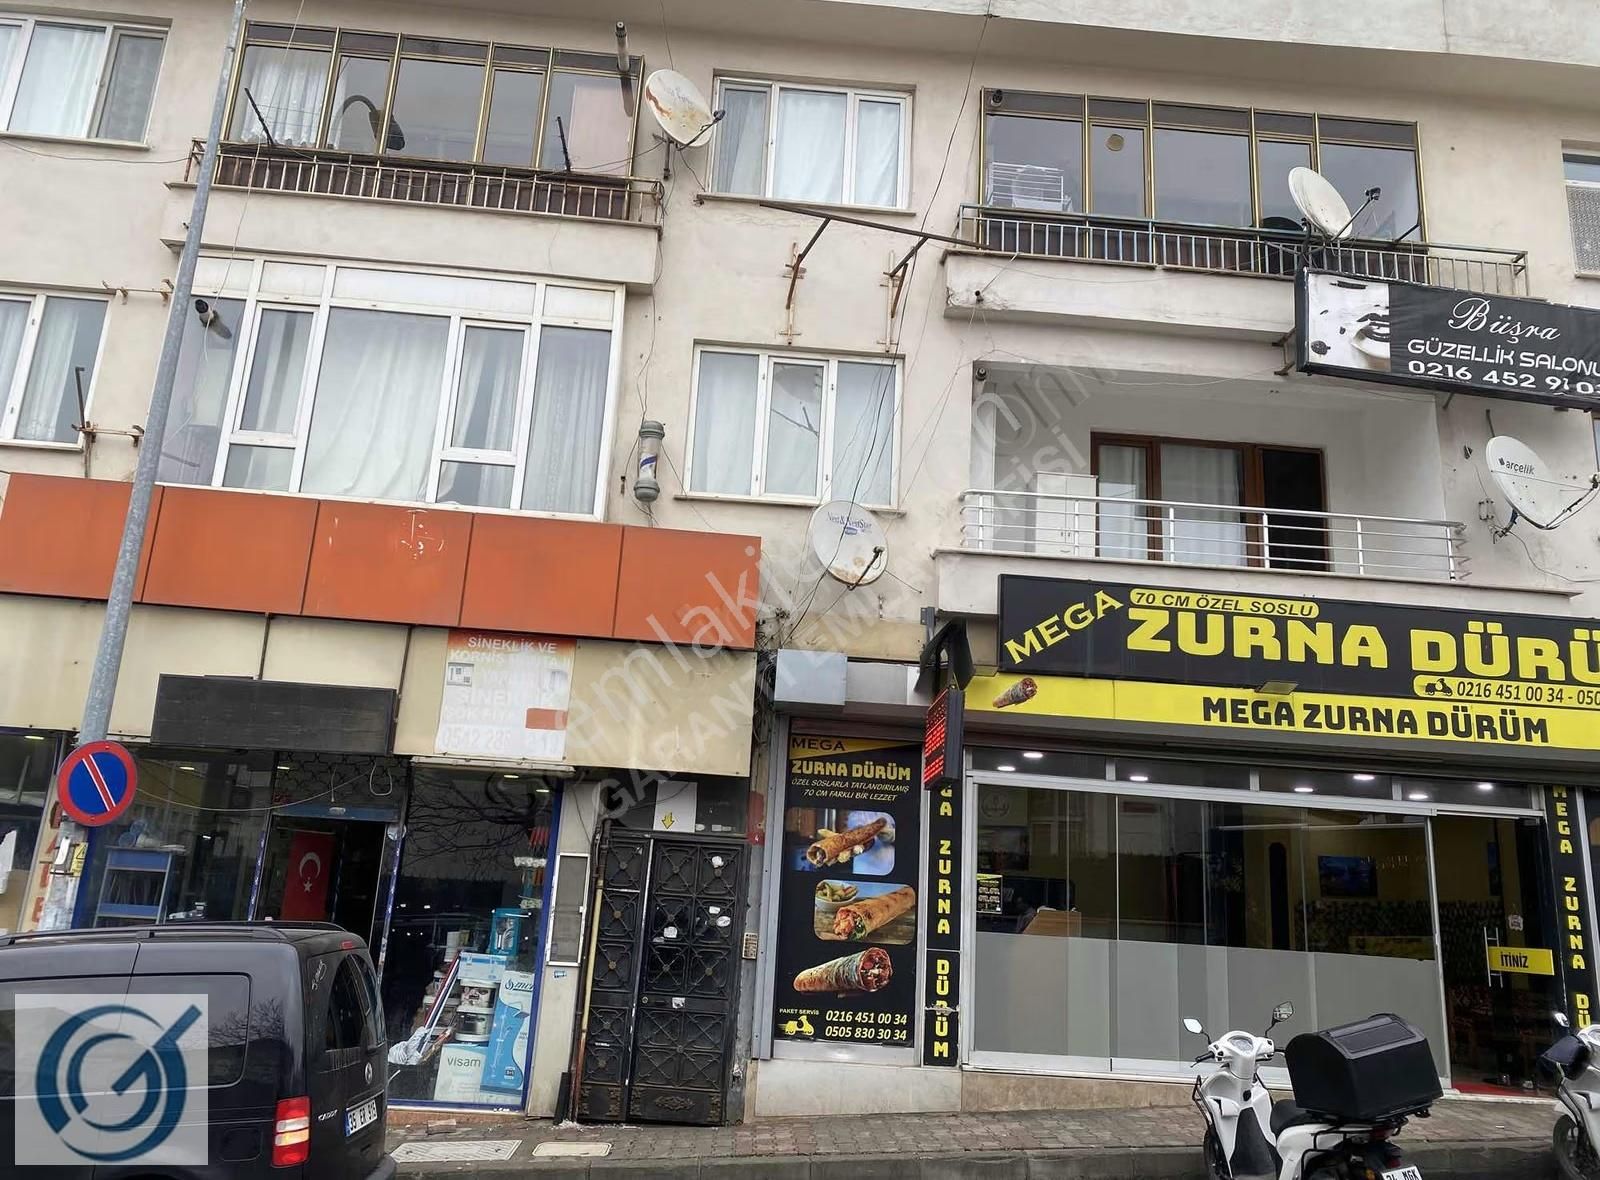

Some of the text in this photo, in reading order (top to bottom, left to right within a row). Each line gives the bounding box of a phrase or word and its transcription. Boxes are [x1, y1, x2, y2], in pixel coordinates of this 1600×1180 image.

[1448, 297, 1560, 344] Büşra
[1408, 337, 1515, 365] GÜZELLİK
[1408, 360, 1474, 381] 0216
[1483, 370, 1537, 388] 452
[1135, 592, 1314, 616] 70 CM ÖZEL SOSLU
[1004, 589, 1124, 664] MEGA
[468, 636, 557, 653] SİNEKLİK VE
[1127, 607, 1600, 685] ZURNA DÜRÜ
[1457, 681, 1491, 698] 0216
[1496, 683, 1521, 700] 451
[1525, 686, 1543, 701] 00
[1547, 687, 1564, 703] 34
[1202, 696, 1549, 743] MEGA ZURNA DÜRÜM
[792, 737, 845, 751] MEGA
[791, 759, 911, 781] ZURNA DÜRÜM
[792, 777, 910, 793] ÖZEL SOSLARLA TATLANDIRILMIŞ
[855, 791, 869, 799] BİR
[870, 793, 898, 802] LEZZET
[937, 840, 951, 934] ZURNA
[1553, 785, 1573, 854] MEGA
[1564, 877, 1585, 970] ZURNA
[1500, 951, 1529, 968] İTİNİZ
[799, 1008, 820, 1016] SERVİS
[825, 1010, 907, 1025] 0216 451 00 34
[825, 1026, 907, 1041] 0505 830 30 34
[447, 1057, 481, 1068] visam
